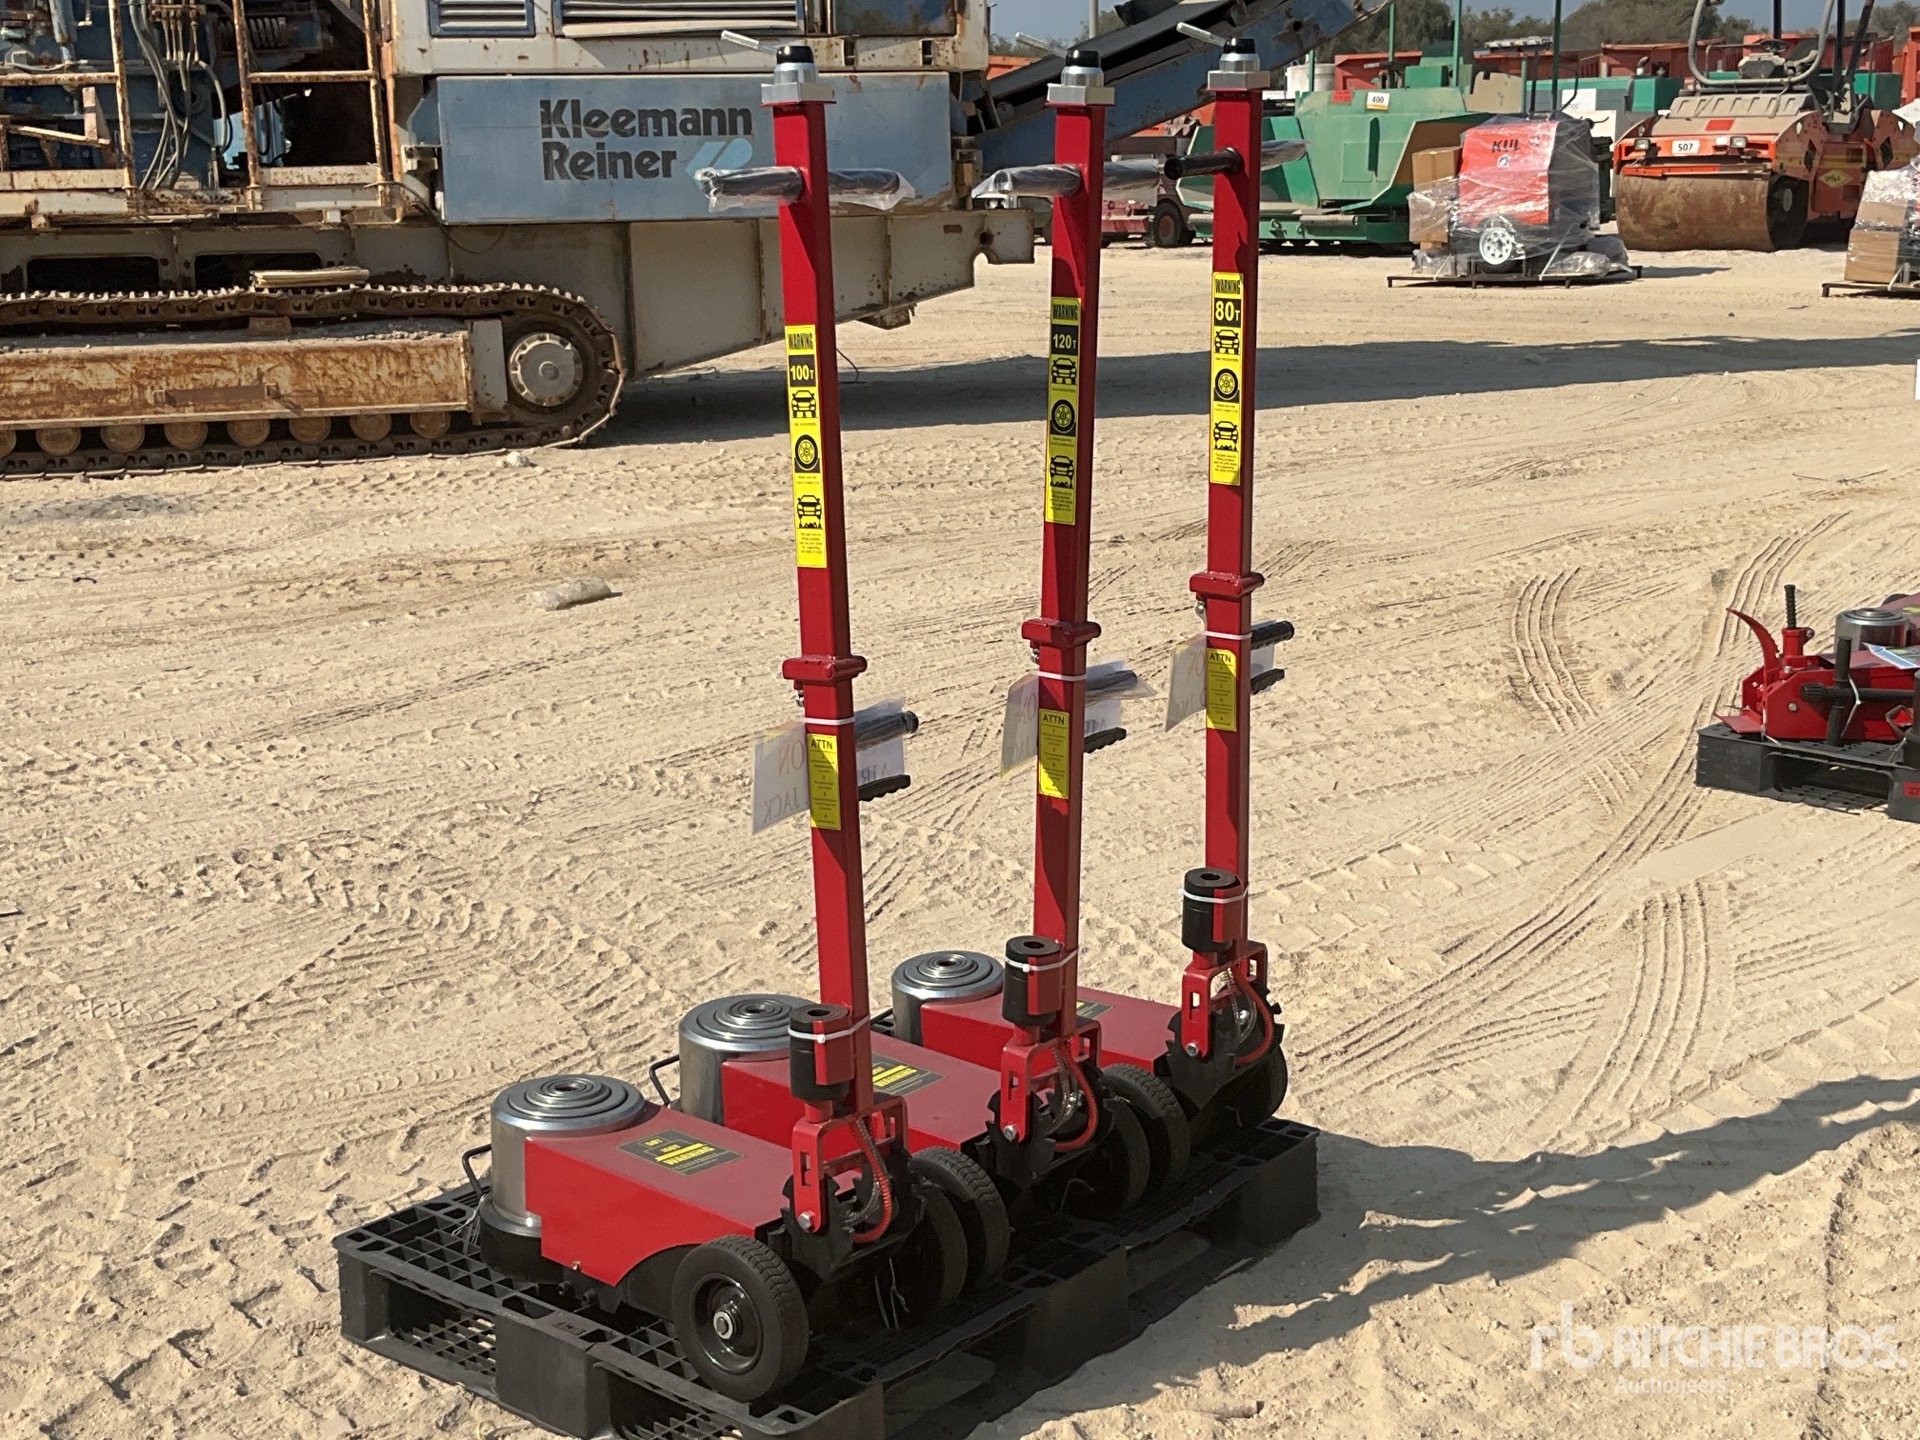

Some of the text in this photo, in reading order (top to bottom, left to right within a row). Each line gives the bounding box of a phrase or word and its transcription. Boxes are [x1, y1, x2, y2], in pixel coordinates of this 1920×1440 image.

[540, 99, 753, 138] Kleemann
[1678, 142, 1694, 152] 507
[542, 141, 677, 180] Reiner
[1215, 279, 1240, 294] WARNING
[1052, 303, 1078, 321] WARNING
[1215, 300, 1241, 321] 80T
[788, 332, 813, 350] WARNING
[1053, 333, 1077, 349] 120T
[790, 364, 814, 381] 100T
[1209, 652, 1231, 663] ATTN
[1043, 714, 1065, 725] ATTN
[811, 738, 833, 750] ATTN
